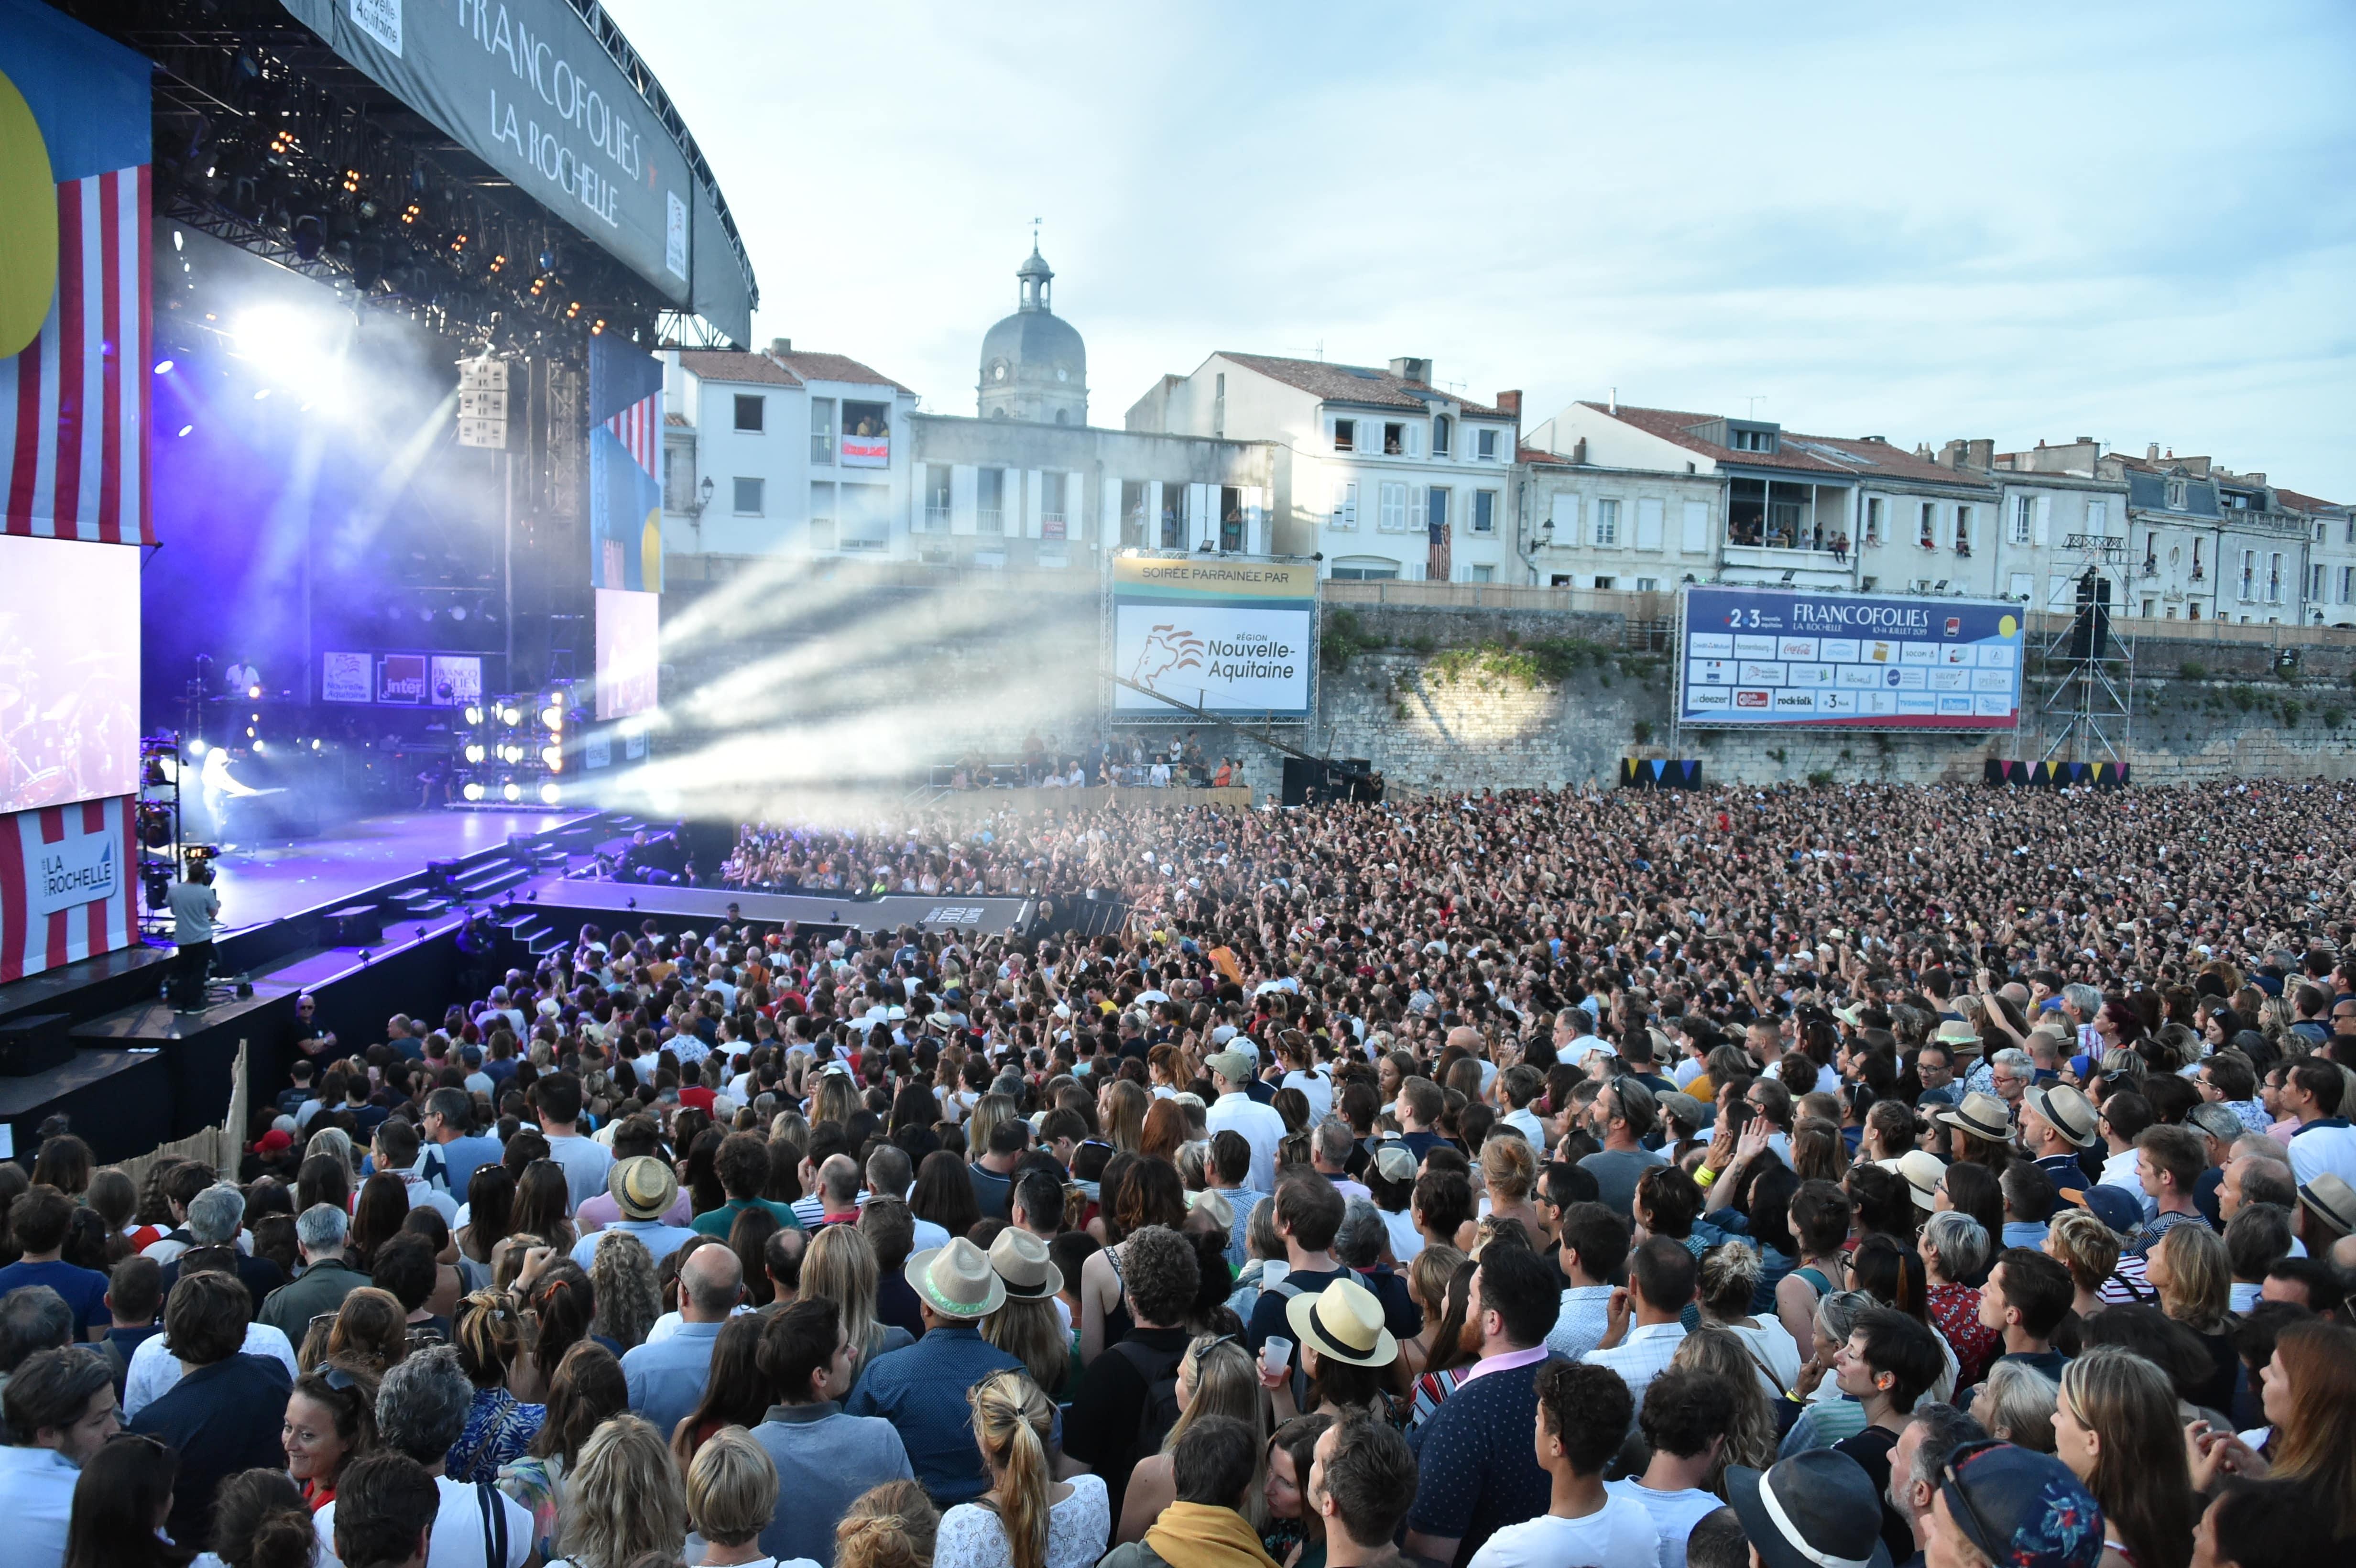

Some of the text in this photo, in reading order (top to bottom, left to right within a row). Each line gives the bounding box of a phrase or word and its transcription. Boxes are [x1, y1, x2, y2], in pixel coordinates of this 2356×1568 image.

[356, 0, 398, 43] Aquitaine
[491, 89, 619, 228] LA ROCHELLE
[1142, 567, 1289, 583] SOIRÉE PARRAINÉE PAR
[1793, 603, 1930, 628] FRANCOFOLIES
[1236, 632, 1267, 642] RÉGION
[1807, 623, 1843, 632] ROCHELLE
[1208, 640, 1296, 658] Nouvelle-
[1208, 660, 1294, 683] Aquitaine
[387, 678, 422, 694] inter
[1699, 694, 1728, 704] deezer
[46, 855, 64, 875] LA
[48, 862, 111, 896] ROCHELLE
